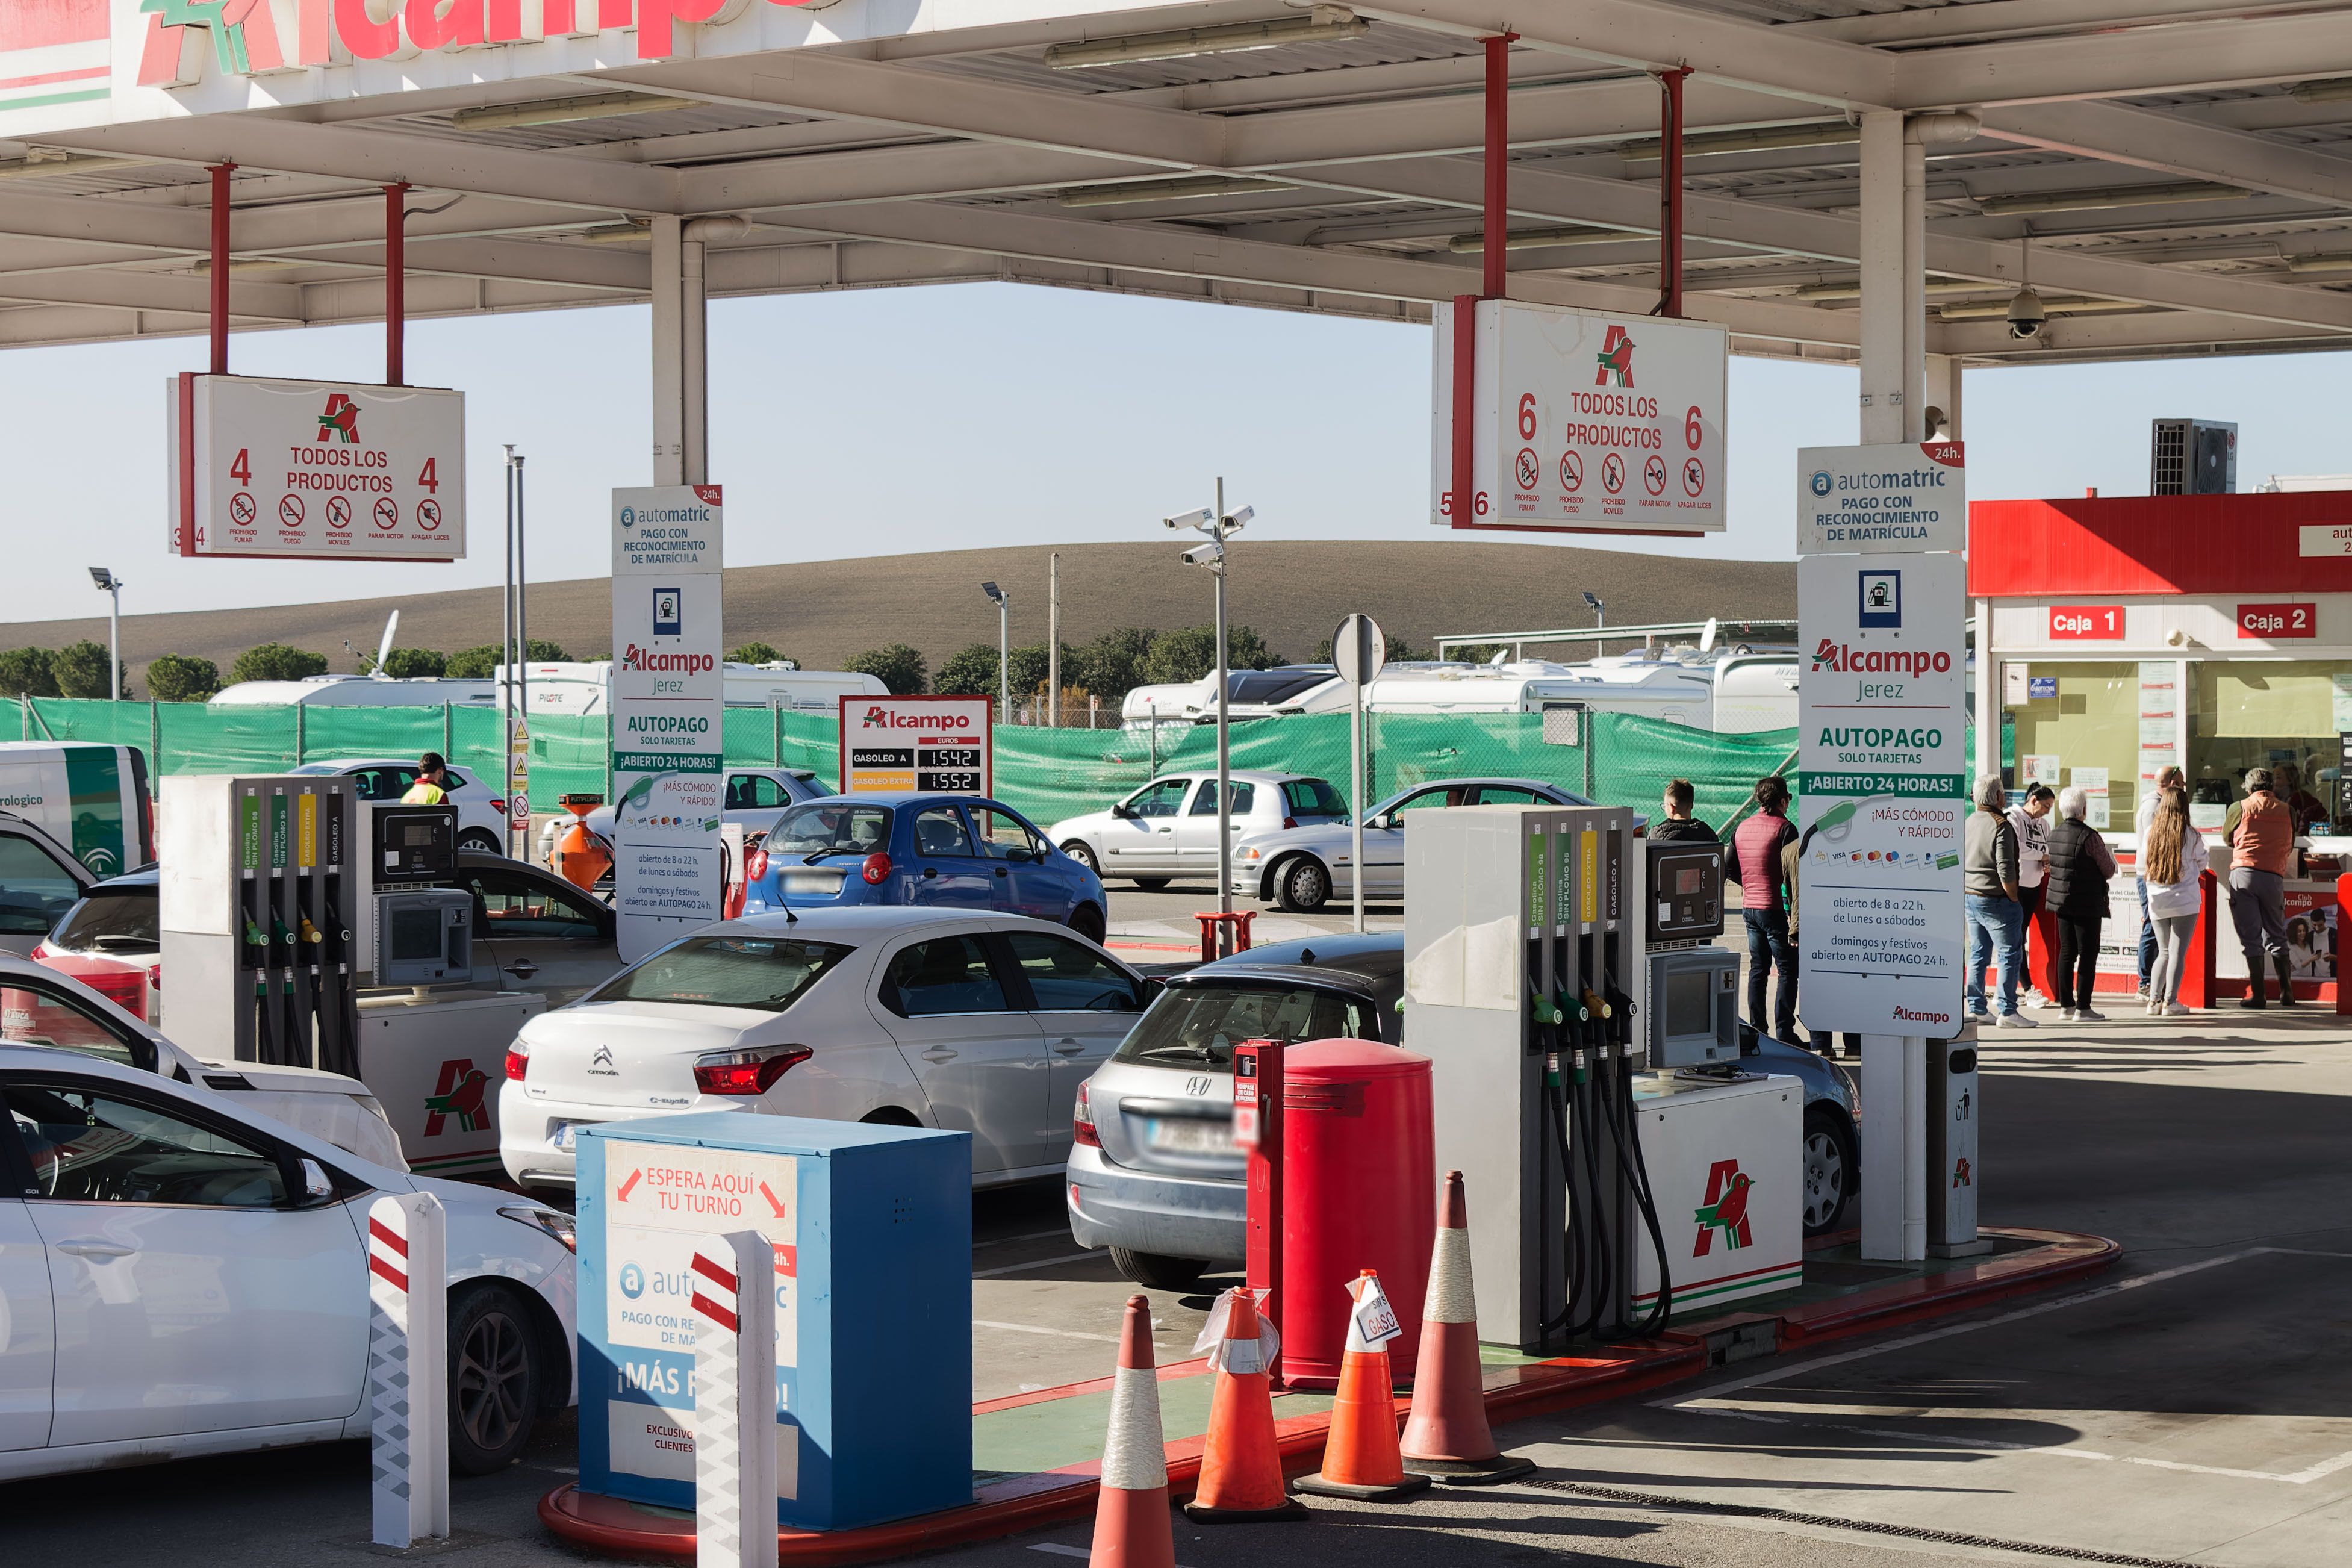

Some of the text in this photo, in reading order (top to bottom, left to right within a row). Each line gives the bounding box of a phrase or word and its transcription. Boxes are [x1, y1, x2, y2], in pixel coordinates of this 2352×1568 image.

[1571, 392, 1657, 418] TODOS LOS
[1519, 393, 1537, 440] 6
[1567, 423, 1661, 449] PRODUCTOS
[1686, 406, 1702, 451] 6
[291, 447, 387, 467] TODOS LOS
[1935, 448, 1961, 459] 24h.
[230, 449, 251, 487] 4
[287, 472, 393, 492] PRODUCTOS
[418, 458, 438, 494] 4
[1838, 467, 1945, 490] automatric
[703, 490, 720, 500] 24h.
[1841, 496, 1912, 509] PAGO CON
[1440, 492, 1452, 515] 5
[1475, 492, 1489, 515] 6
[639, 506, 709, 523] automatric
[1817, 511, 1938, 526] RECONOCIMIENTO
[196, 527, 205, 545] 4
[641, 529, 688, 538] PAGO CON
[1827, 524, 1927, 541] DE MATRÍCULA
[624, 541, 705, 552] RECONOCIMIENTO
[632, 552, 698, 564] DE MATRÍCULA
[2054, 611, 2114, 633] Caja 1
[2244, 609, 2306, 632] Caja 2
[622, 644, 714, 676] Alcampo
[1811, 639, 1950, 679] Alcampo
[652, 677, 683, 695] Jerez
[1856, 680, 1903, 702] Jerez
[628, 717, 708, 733] AUTOPAGO
[863, 706, 969, 731] Alcampo
[641, 736, 695, 745] SOLO TARJETAS
[1819, 727, 1942, 748] AUTOPAGO
[621, 756, 715, 769] ¡ABIERTO 24 HORAS!
[933, 751, 971, 766] 1.542
[1838, 753, 1922, 764] SOLO TARJETAS
[663, 781, 716, 793] ¡MÁS CÓMODO
[933, 773, 971, 789] 1.552
[1808, 777, 1953, 792] ¡ABIERTO 24 HORAS!
[680, 795, 716, 806] Y RÁPIDO!
[1871, 808, 1954, 822] ¡MÁS CÓMODO
[1898, 825, 1953, 838] Y RÁPIDO!
[639, 854, 661, 863] abierto
[672, 856, 676, 864] 8
[683, 856, 691, 865] 22
[639, 867, 698, 877] de lunes sábados
[638, 886, 700, 897] domingos festivos
[625, 898, 648, 907] abierto
[659, 899, 695, 909] AUTOPAGO
[697, 900, 705, 909] 24
[1833, 898, 1925, 910] abierto de 8 22 h.
[2284, 898, 2312, 907] lcampo
[1833, 913, 1926, 926] de lunes sábados
[1831, 936, 1927, 950] domingos y festivos
[1811, 951, 1846, 961] abierto
[1862, 953, 1921, 964] AUTOPAGO
[1924, 956, 1936, 965] 24
[1893, 1006, 1949, 1024] Alcampo
[647, 1168, 753, 1194] ESPERA AQUÍ
[658, 1192, 742, 1217] TU TURNO
[774, 1252, 789, 1267] 4h.
[622, 1311, 652, 1325] PAGO
[655, 1314, 677, 1327] CON
[661, 1331, 675, 1344] DE
[617, 1360, 679, 1394] ¡MÁS
[647, 1424, 693, 1439] EXCLUSIVO
[655, 1440, 693, 1452] CLIENTES
